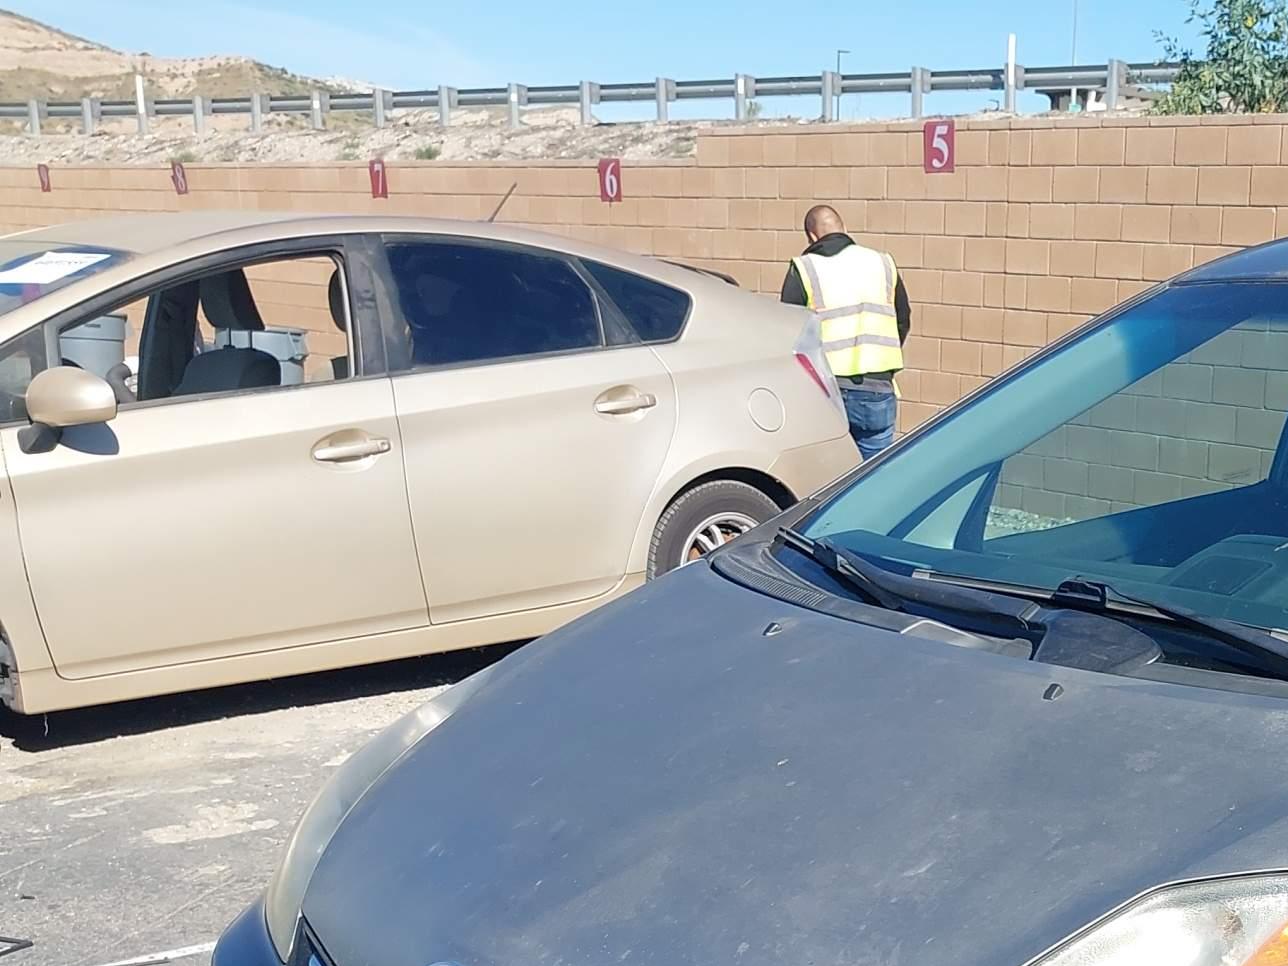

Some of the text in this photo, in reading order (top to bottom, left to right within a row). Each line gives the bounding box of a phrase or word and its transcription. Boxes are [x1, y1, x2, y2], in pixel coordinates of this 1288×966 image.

[932, 125, 949, 168] 5
[175, 165, 186, 191] 8
[373, 163, 383, 195] 7
[604, 162, 618, 198] 6
